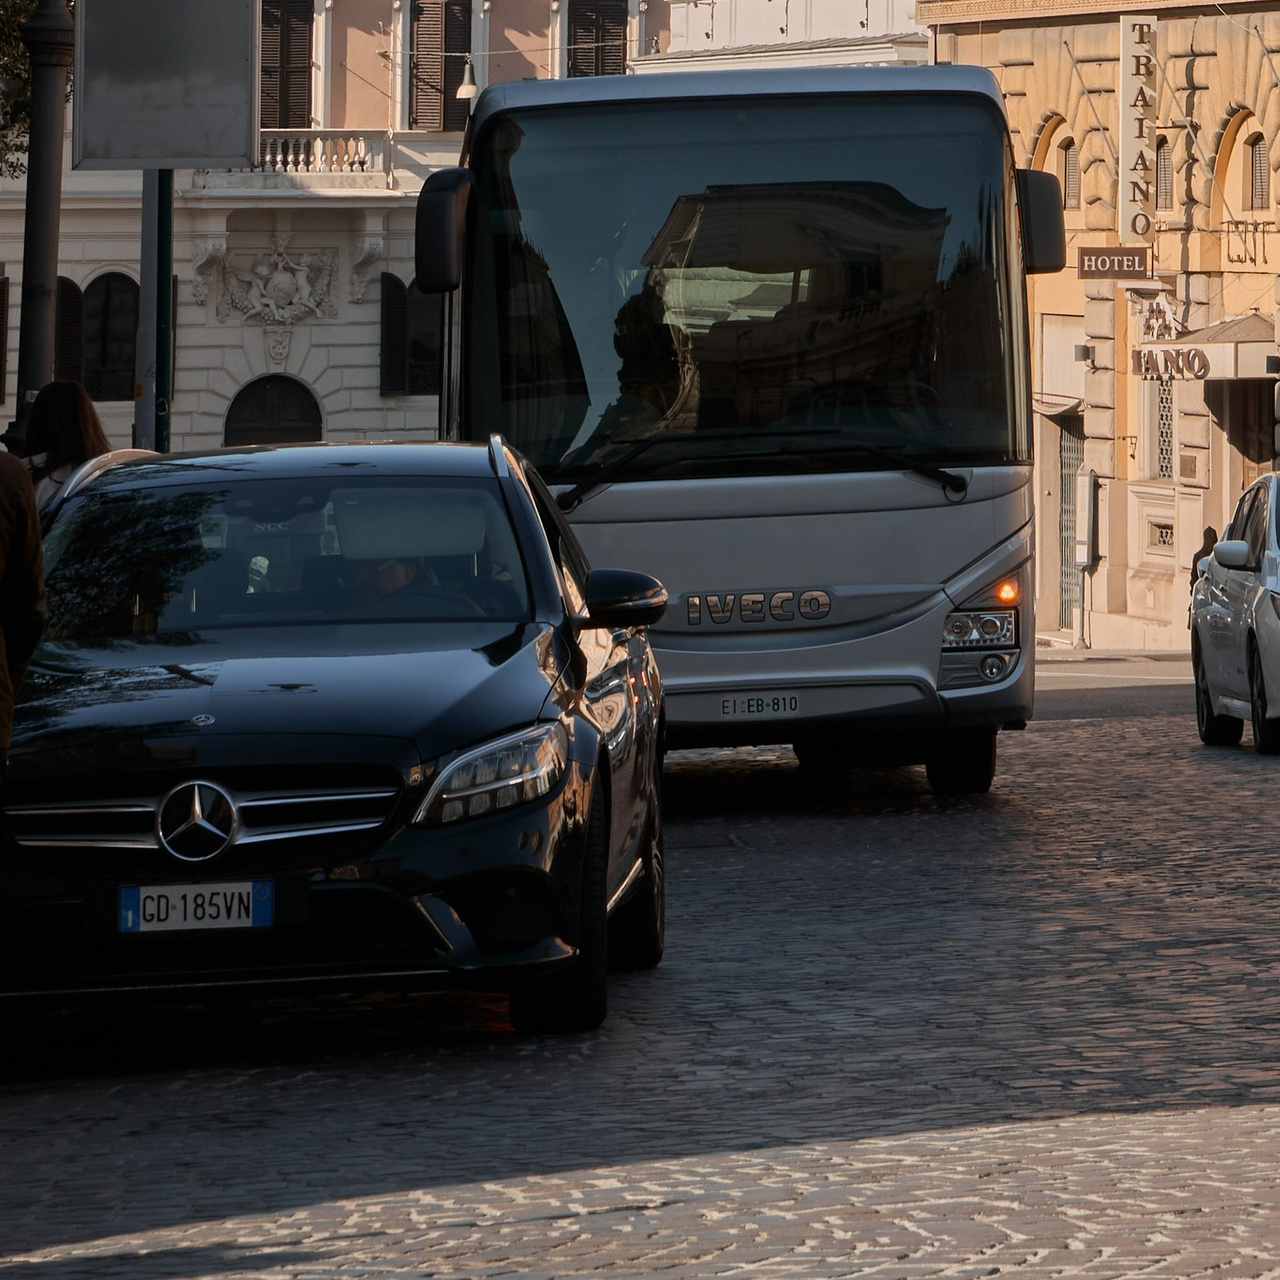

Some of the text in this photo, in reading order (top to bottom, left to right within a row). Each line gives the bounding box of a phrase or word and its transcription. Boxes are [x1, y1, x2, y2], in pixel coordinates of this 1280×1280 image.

[1130, 23, 1154, 236] TRAIANO
[1082, 256, 1144, 272] HOTEL
[255, 522, 289, 532] NCC
[687, 590, 831, 626] IVECO
